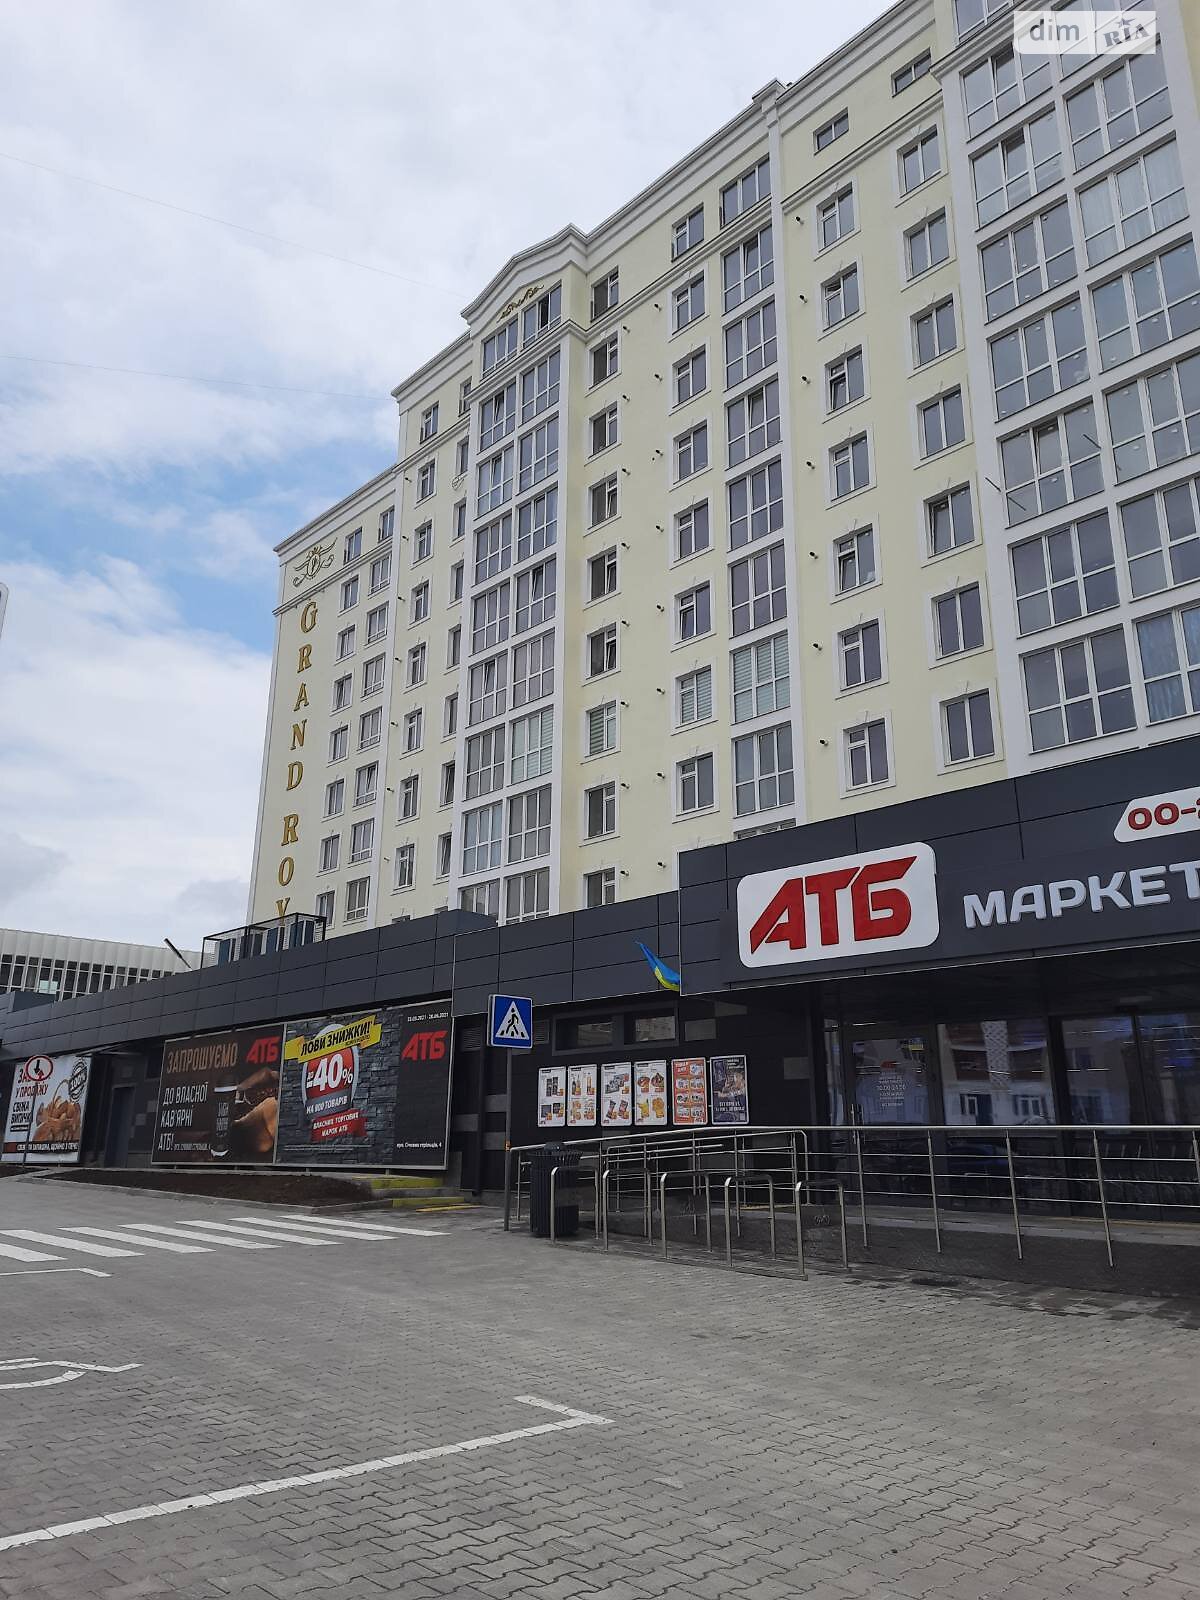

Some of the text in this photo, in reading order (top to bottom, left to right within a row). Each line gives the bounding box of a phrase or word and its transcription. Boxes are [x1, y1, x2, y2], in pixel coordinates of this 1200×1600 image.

[749, 855, 1200, 955] АТБ МАРКЕТ
[246, 1036, 282, 1064] АТБ
[300, 1036, 327, 1057] ЛОВИ
[326, 1020, 371, 1047] ЗНИЖКИ!
[400, 1030, 448, 1061] АТБ
[166, 1042, 239, 1074] ЗАПРОШУЄМО
[162, 1081, 209, 1106] ДО ВЛАСНОЇ
[158, 1132, 175, 1151] АТБ!
